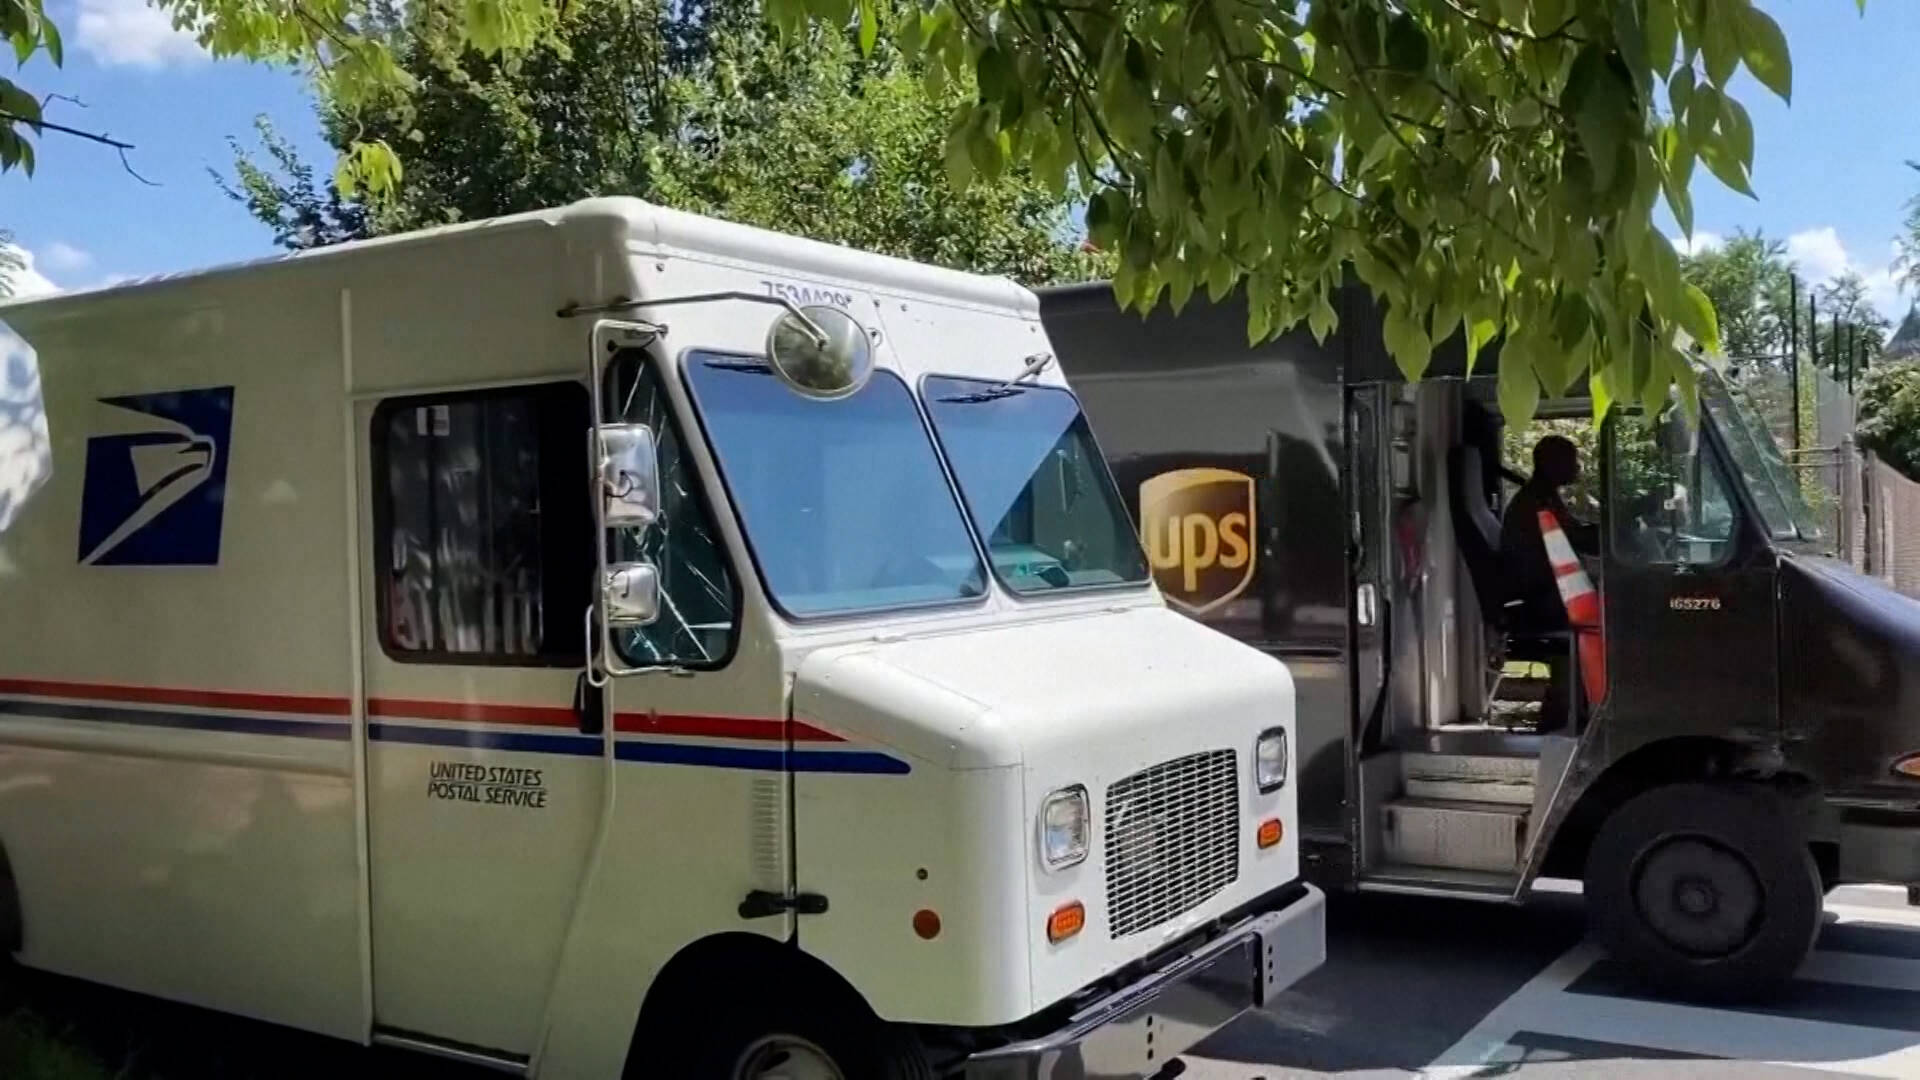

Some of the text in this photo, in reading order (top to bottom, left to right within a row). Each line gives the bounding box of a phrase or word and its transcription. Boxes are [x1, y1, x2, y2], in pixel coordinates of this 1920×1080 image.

[1150, 512, 1249, 592] ups
[429, 760, 544, 787] UNITED STATES
[427, 780, 548, 809] POSTAL SERVICE
